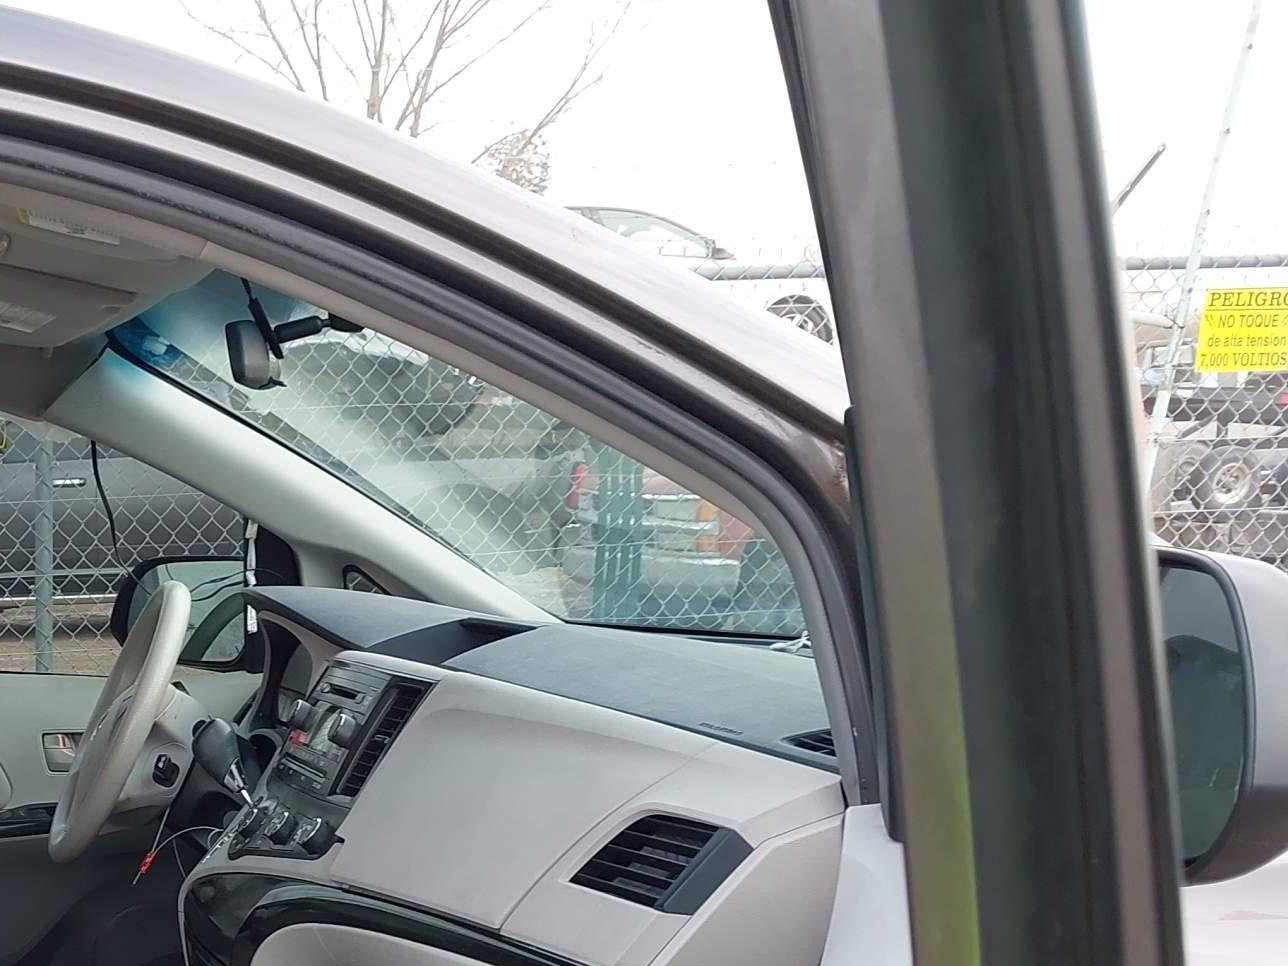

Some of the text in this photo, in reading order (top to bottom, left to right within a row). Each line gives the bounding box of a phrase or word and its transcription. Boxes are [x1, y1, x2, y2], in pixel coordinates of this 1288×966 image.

[1218, 314, 1280, 328] NO TOQUE
[1208, 334, 1221, 347] de
[1223, 333, 1243, 347] alta
[1232, 352, 1287, 367] VOLTIOS
